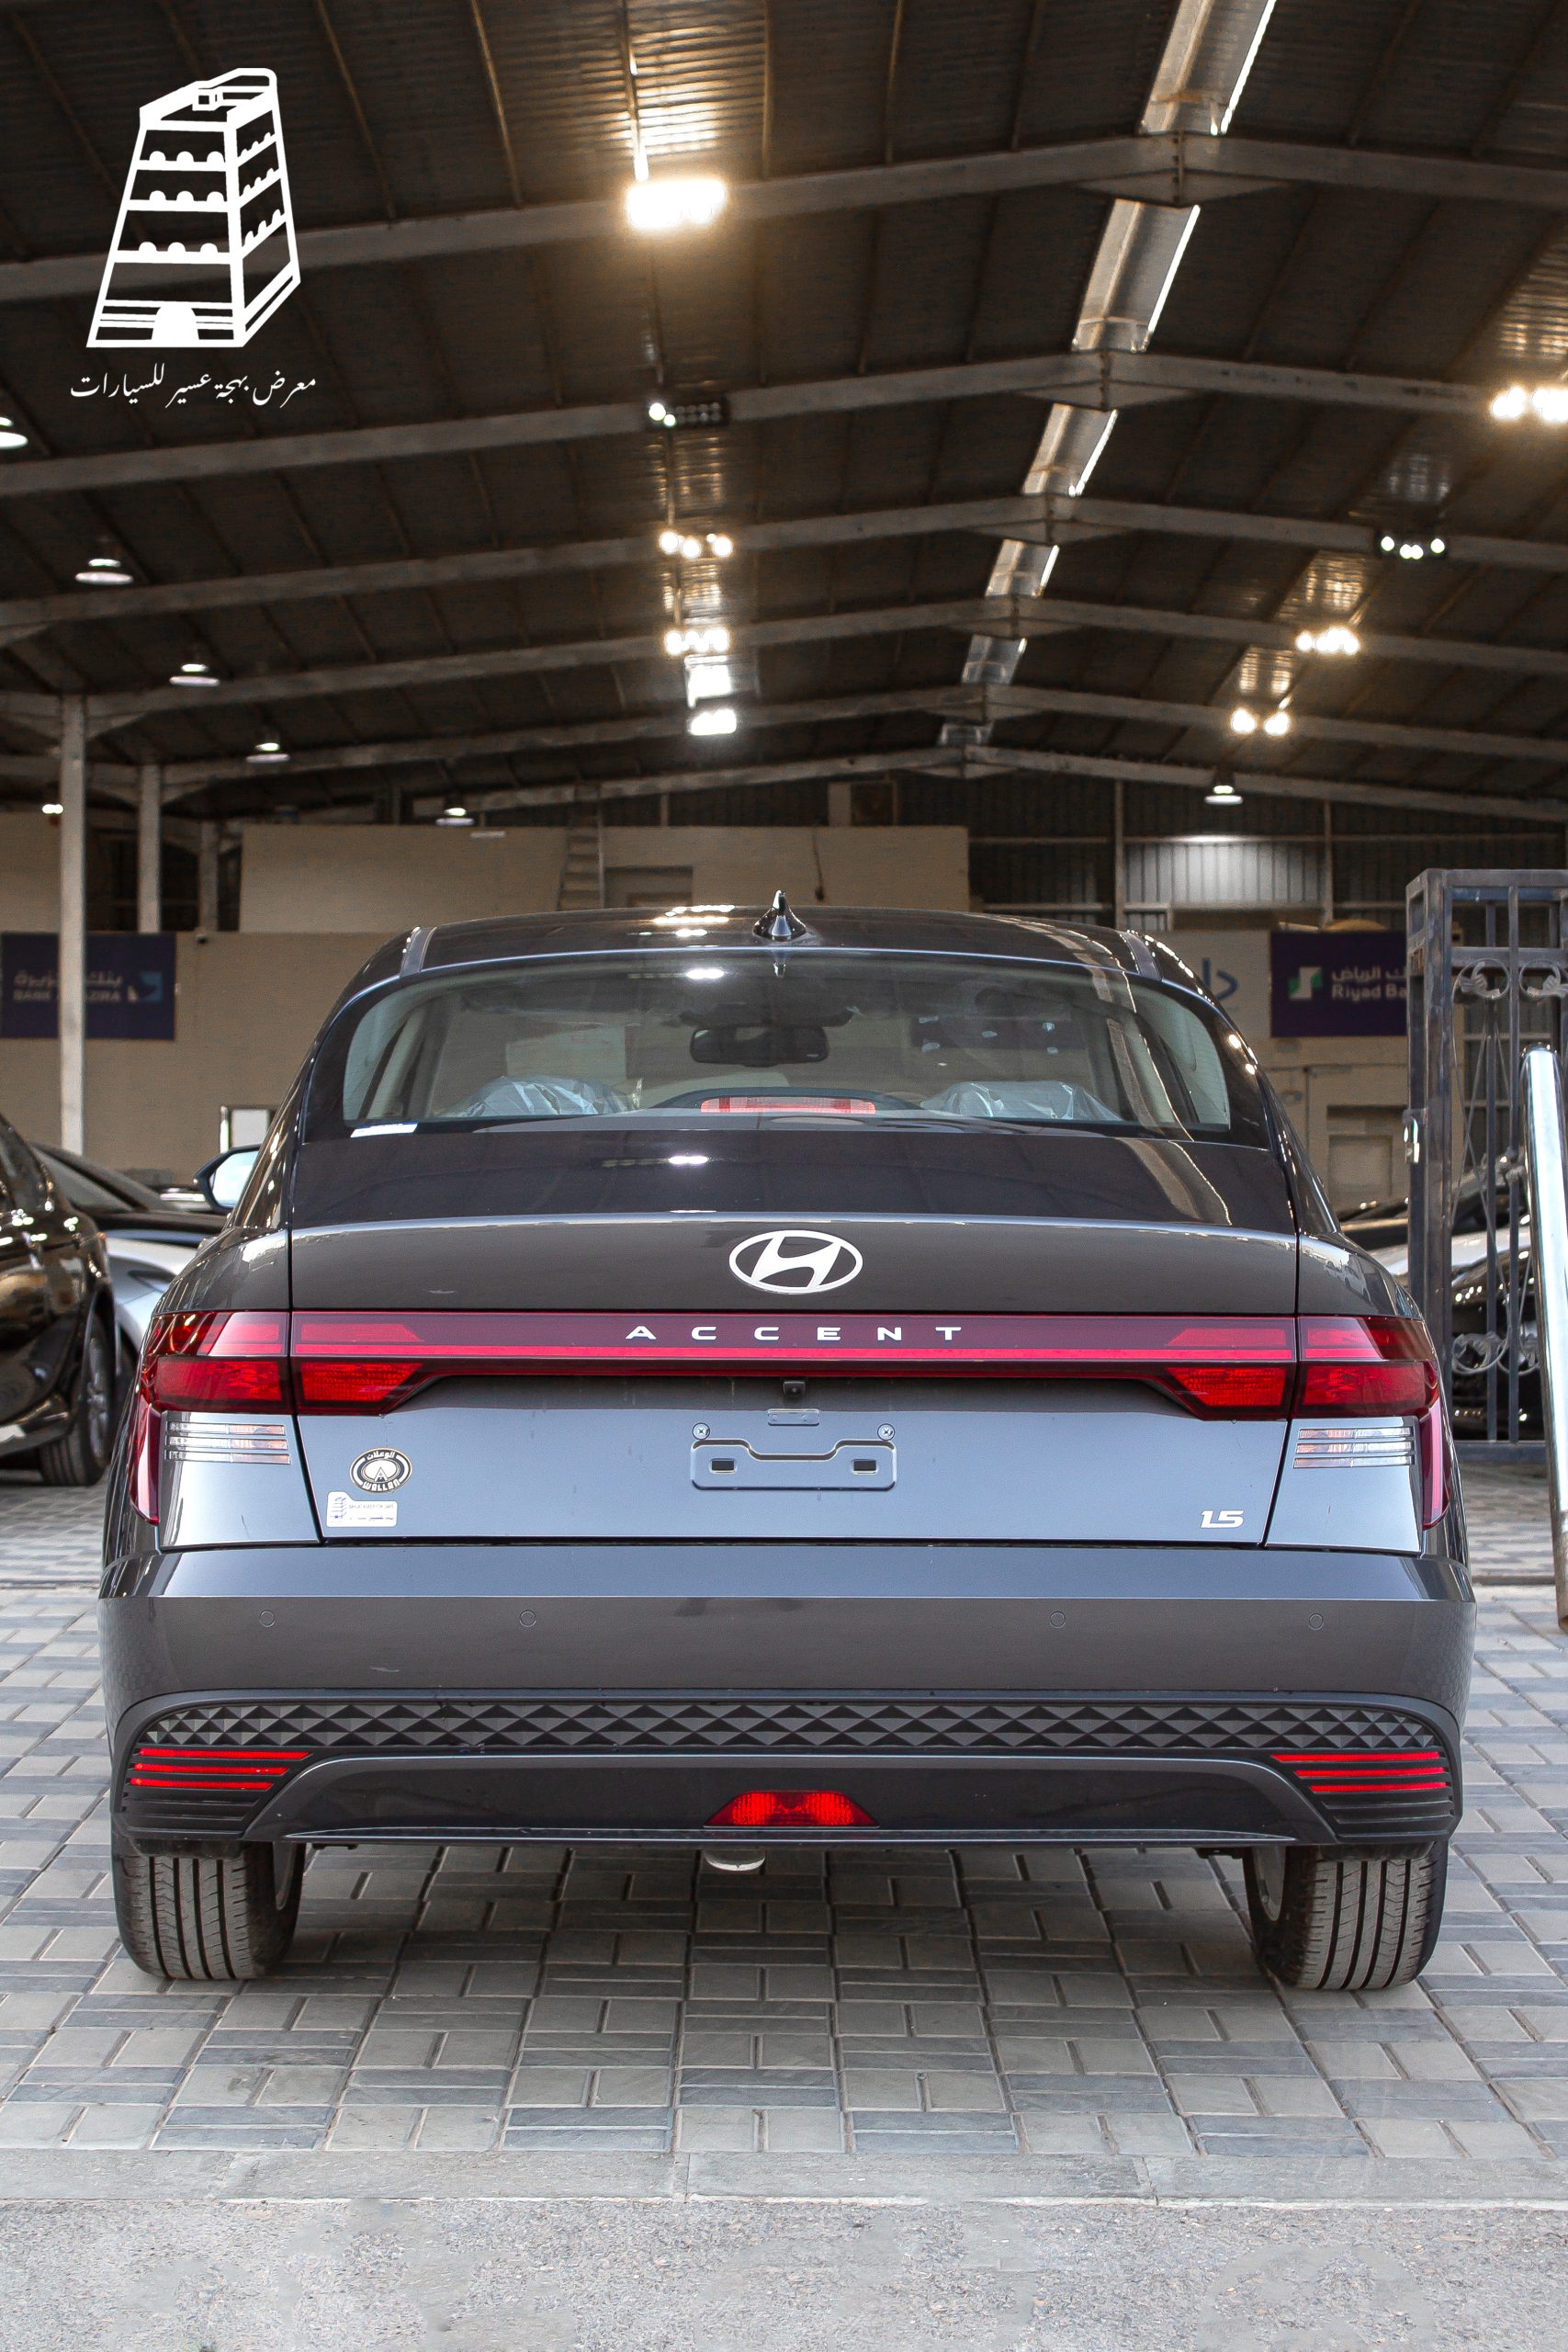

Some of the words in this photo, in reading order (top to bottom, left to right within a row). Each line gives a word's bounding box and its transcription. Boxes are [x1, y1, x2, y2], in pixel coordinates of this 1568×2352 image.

[1331, 983, 1382, 1001] Riyad
[1385, 983, 1407, 1000] Ba
[625, 1325, 963, 1342] ACCENT
